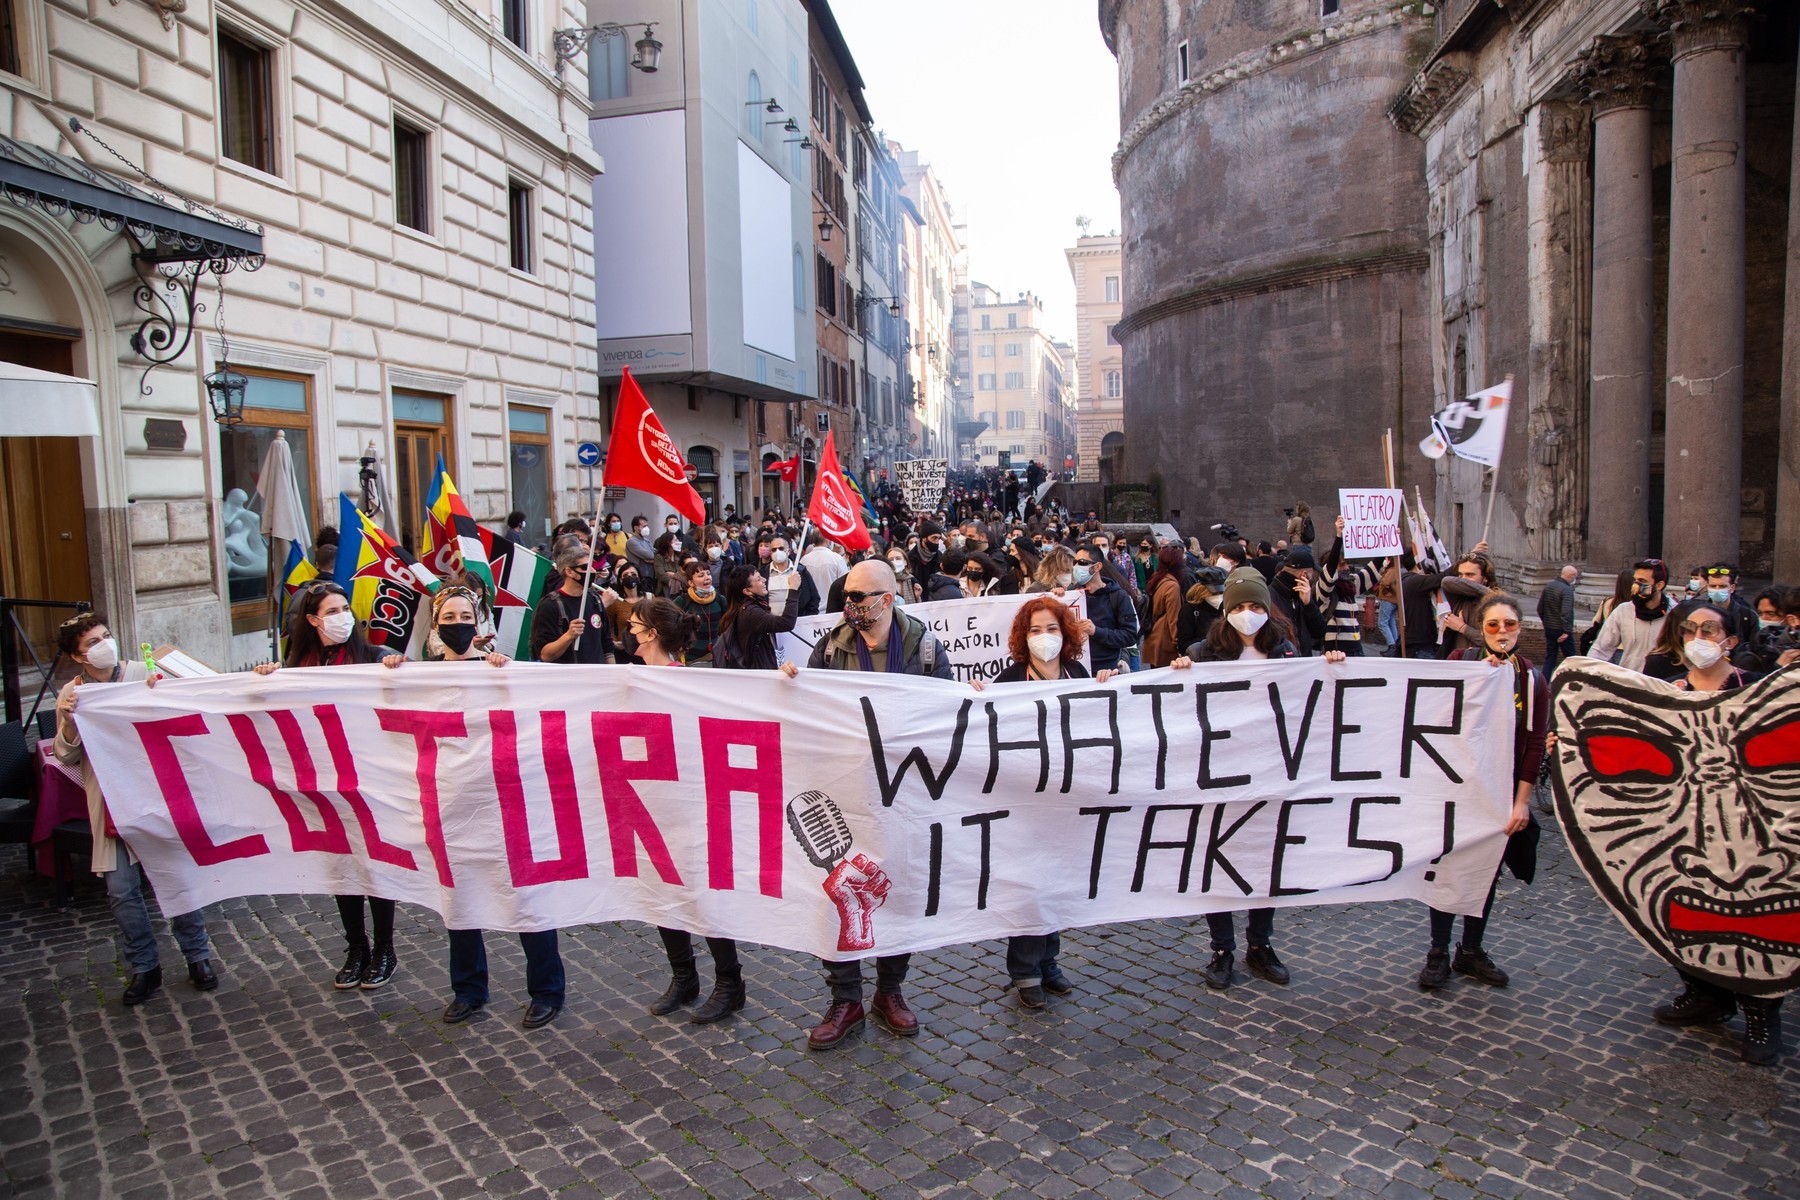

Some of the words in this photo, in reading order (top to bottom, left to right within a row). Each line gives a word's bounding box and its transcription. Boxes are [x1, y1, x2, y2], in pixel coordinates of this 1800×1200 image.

[657, 459, 675, 477] ROMA
[894, 462, 908, 471] UN
[897, 471, 915, 480] NON
[917, 471, 947, 479] INVESTE
[911, 480, 941, 488] PROPRIO
[910, 488, 942, 498] TEATRO
[1343, 504, 1352, 520] IL
[1346, 495, 1394, 520] TEATRO
[1351, 525, 1398, 549] NECESSARIO
[967, 616, 978, 630] E
[133, 703, 783, 899] CULTURA
[859, 678, 1465, 807] WHATEVER
[925, 810, 1010, 917] IT
